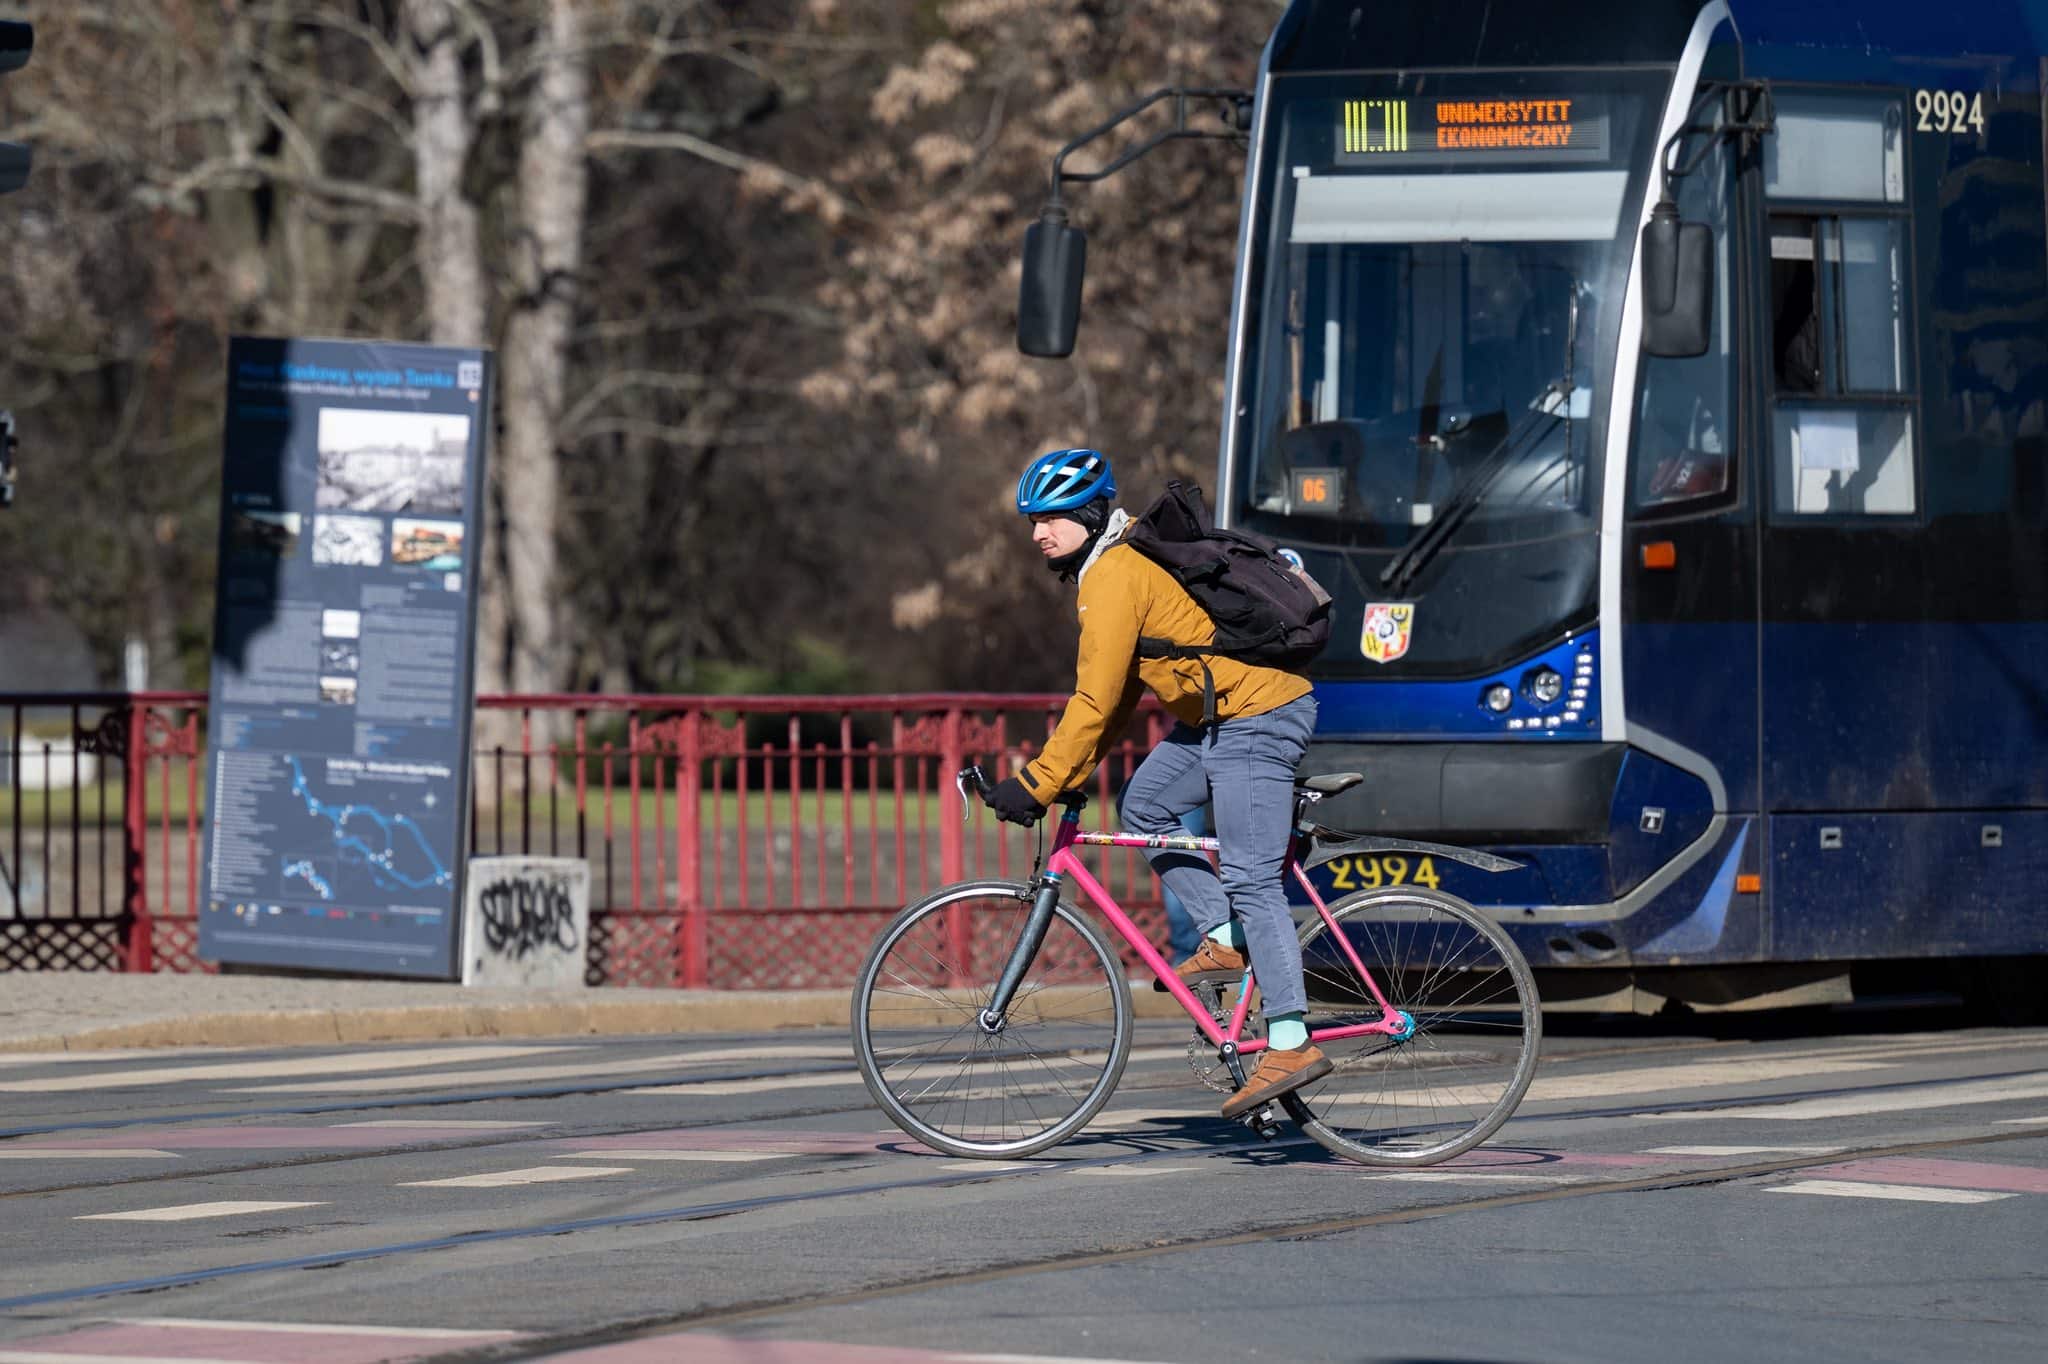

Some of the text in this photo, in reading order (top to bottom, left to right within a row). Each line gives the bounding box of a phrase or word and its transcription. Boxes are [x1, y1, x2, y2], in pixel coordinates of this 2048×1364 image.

[1436, 100, 1571, 124] UNIWERSYTET
[1915, 89, 1985, 135] 2924
[1436, 124, 1572, 148] EKONOMICZNY
[1303, 478, 1326, 502] 06
